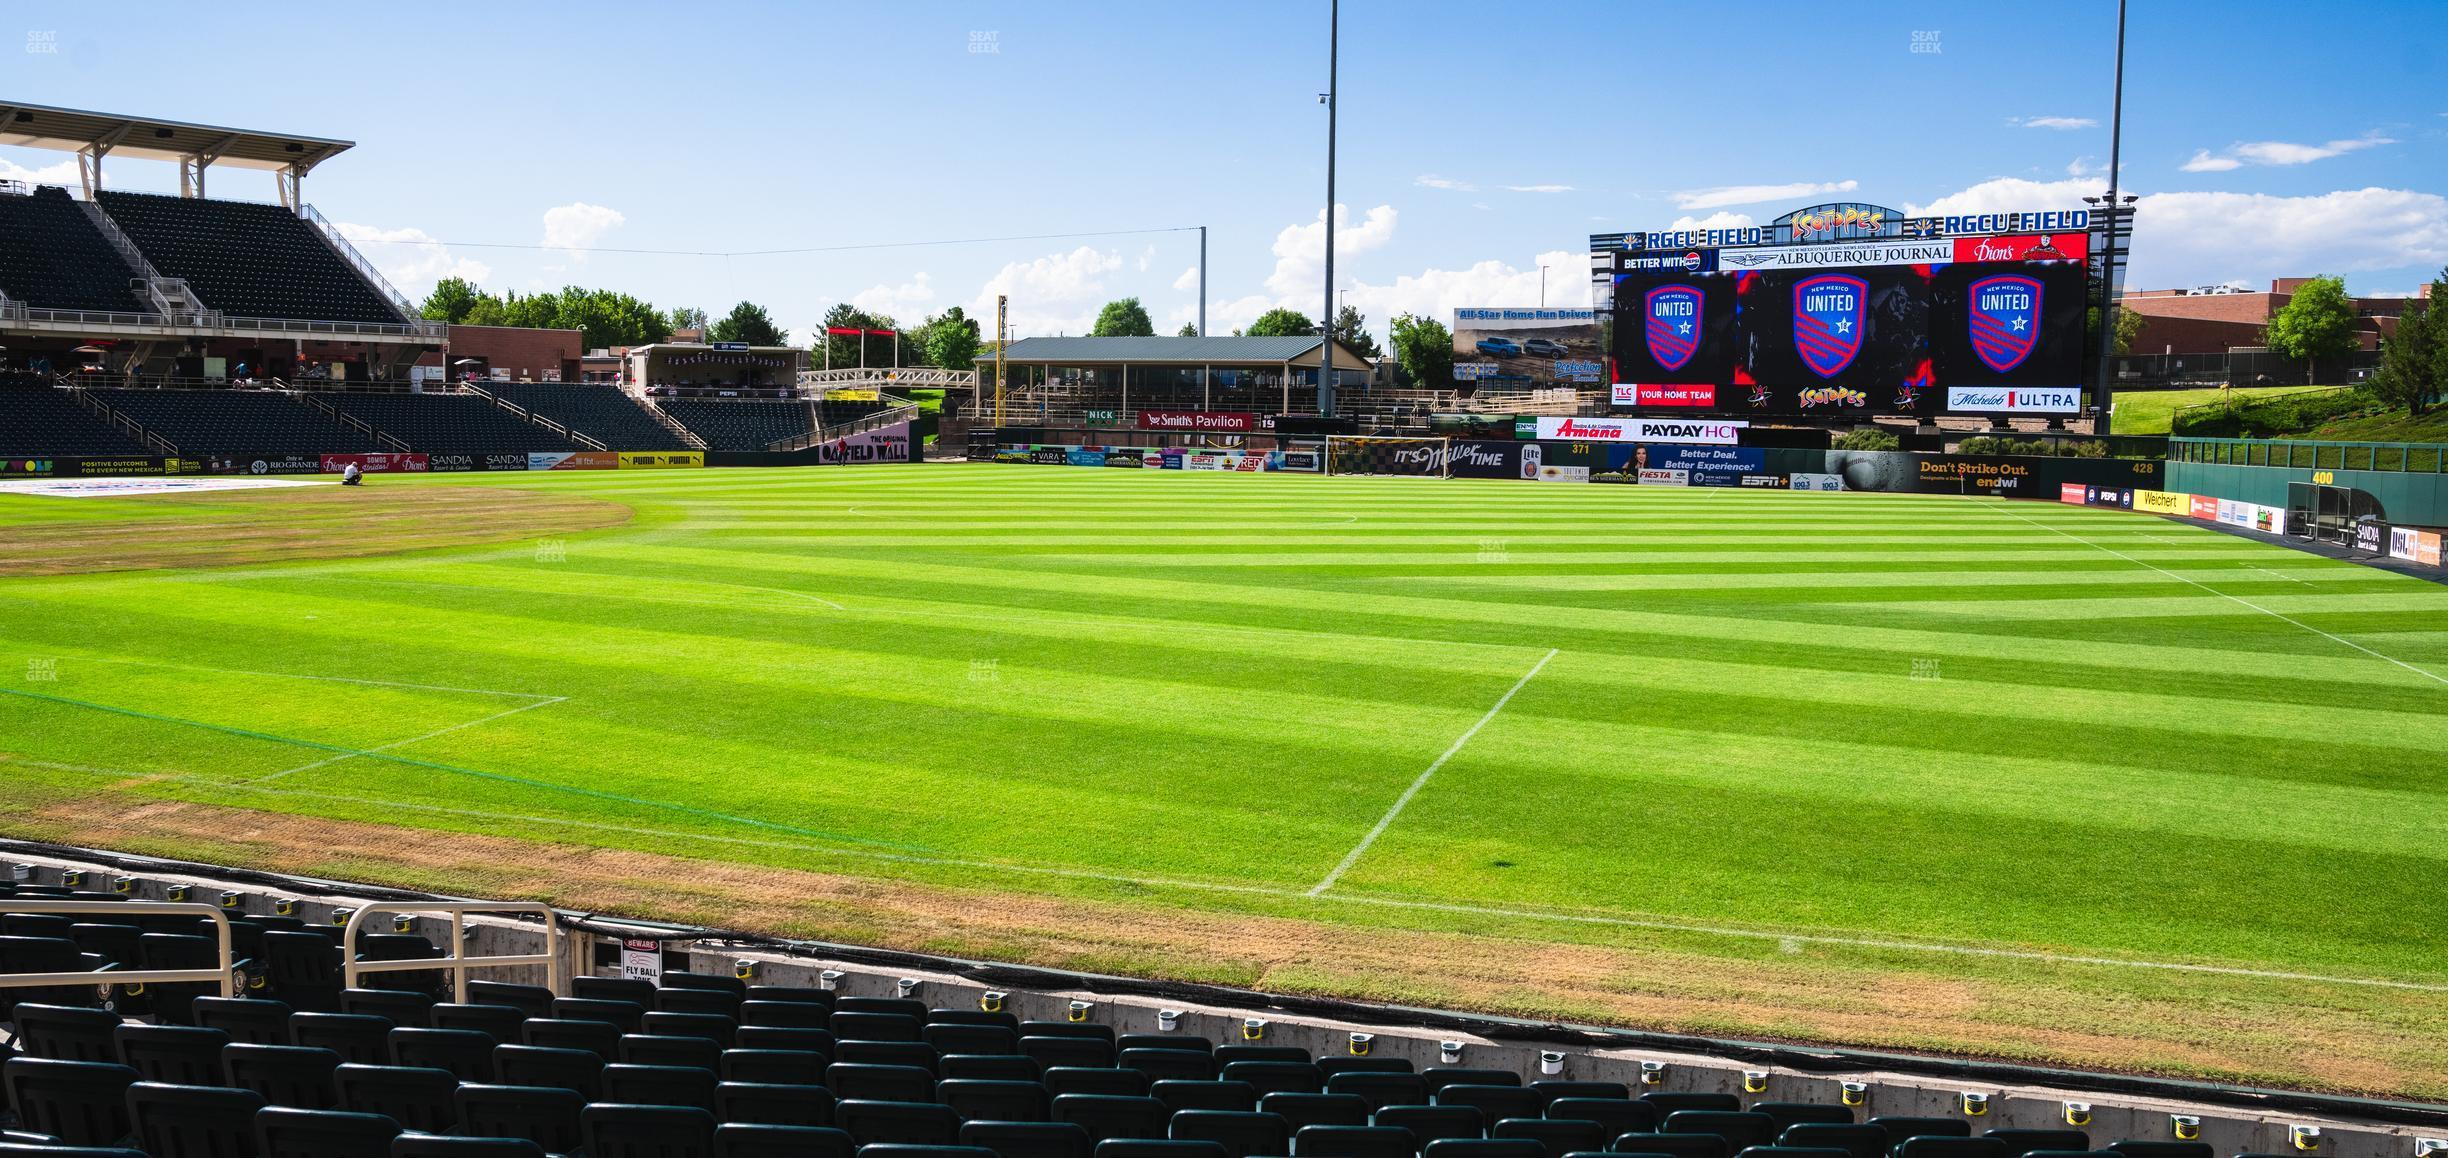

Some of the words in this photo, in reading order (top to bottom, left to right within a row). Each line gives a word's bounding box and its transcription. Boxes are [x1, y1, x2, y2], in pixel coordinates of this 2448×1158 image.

[1790, 207, 1884, 239] ISOTOPES
[1945, 213, 2009, 233] RGCU
[2020, 210, 2089, 230] FIELD
[1647, 230, 1698, 249] RGCU
[1707, 227, 1762, 246] FIELD
[1974, 238, 2014, 261] Dion's
[1777, 249, 1882, 265] ALBUQUERQUE
[1884, 246, 1951, 262] JOURNAL
[1624, 258, 1660, 269] BETTER
[1662, 257, 1686, 268] WITH
[1806, 295, 1854, 312] UNITED
[1982, 294, 2029, 311] UNITED
[1655, 302, 1693, 316] UNITED
[1503, 310, 1535, 320] Home
[1536, 311, 1556, 320] Run
[1840, 322, 1848, 330] 18
[2016, 319, 2023, 327] 18
[1615, 387, 1632, 396] TLC
[1640, 391, 1662, 399] YOUR
[1664, 391, 1687, 399] HOME
[1690, 391, 1712, 399] TEAM
[1798, 386, 1867, 408] ISOTOPES
[1952, 392, 2007, 406] Michelob
[2020, 394, 2074, 406] ULTRA
[1089, 411, 1113, 419] NICK
[1161, 414, 1193, 426] Smith's
[1196, 416, 1243, 427] Pavilion
[1262, 419, 1275, 428] 19
[1556, 419, 1622, 438] Amana
[1642, 424, 1704, 437] PAYDAY
[876, 445, 907, 460] WALL
[1524, 448, 1540, 459] Lite
[1572, 443, 1589, 454] 371
[367, 456, 387, 464] SOMOS
[431, 455, 473, 465] SANDIA
[486, 454, 527, 464] SANDIA
[632, 456, 655, 464] PUMA
[668, 455, 690, 464] PUMA
[1038, 452, 1059, 460] VARA
[1394, 450, 1419, 464] IT'S
[1416, 443, 1482, 472] Miller
[1470, 453, 1504, 466] TIME
[1680, 450, 1711, 459] Better
[1713, 450, 1737, 459] Deal.
[402, 457, 427, 472] Dion's
[1242, 459, 1261, 467] RED
[1664, 461, 1694, 469] Better
[1920, 461, 1955, 473] Don't
[1957, 462, 1999, 474] Strike
[2000, 464, 2028, 475] Out.
[2132, 463, 2154, 473] 428
[1639, 471, 1671, 479] FIESTA
[2312, 472, 2333, 484] 400
[1793, 480, 1811, 488] 100.3
[1822, 481, 1839, 489] 100.3
[1976, 477, 2018, 488] endwi
[2100, 491, 2117, 502] PEPSI
[2144, 492, 2177, 508] Weichert
[2356, 524, 2380, 542] SANDIA
[628, 939, 655, 949] BEWARE
[626, 966, 638, 974] FLY
[640, 967, 658, 977] BALL
